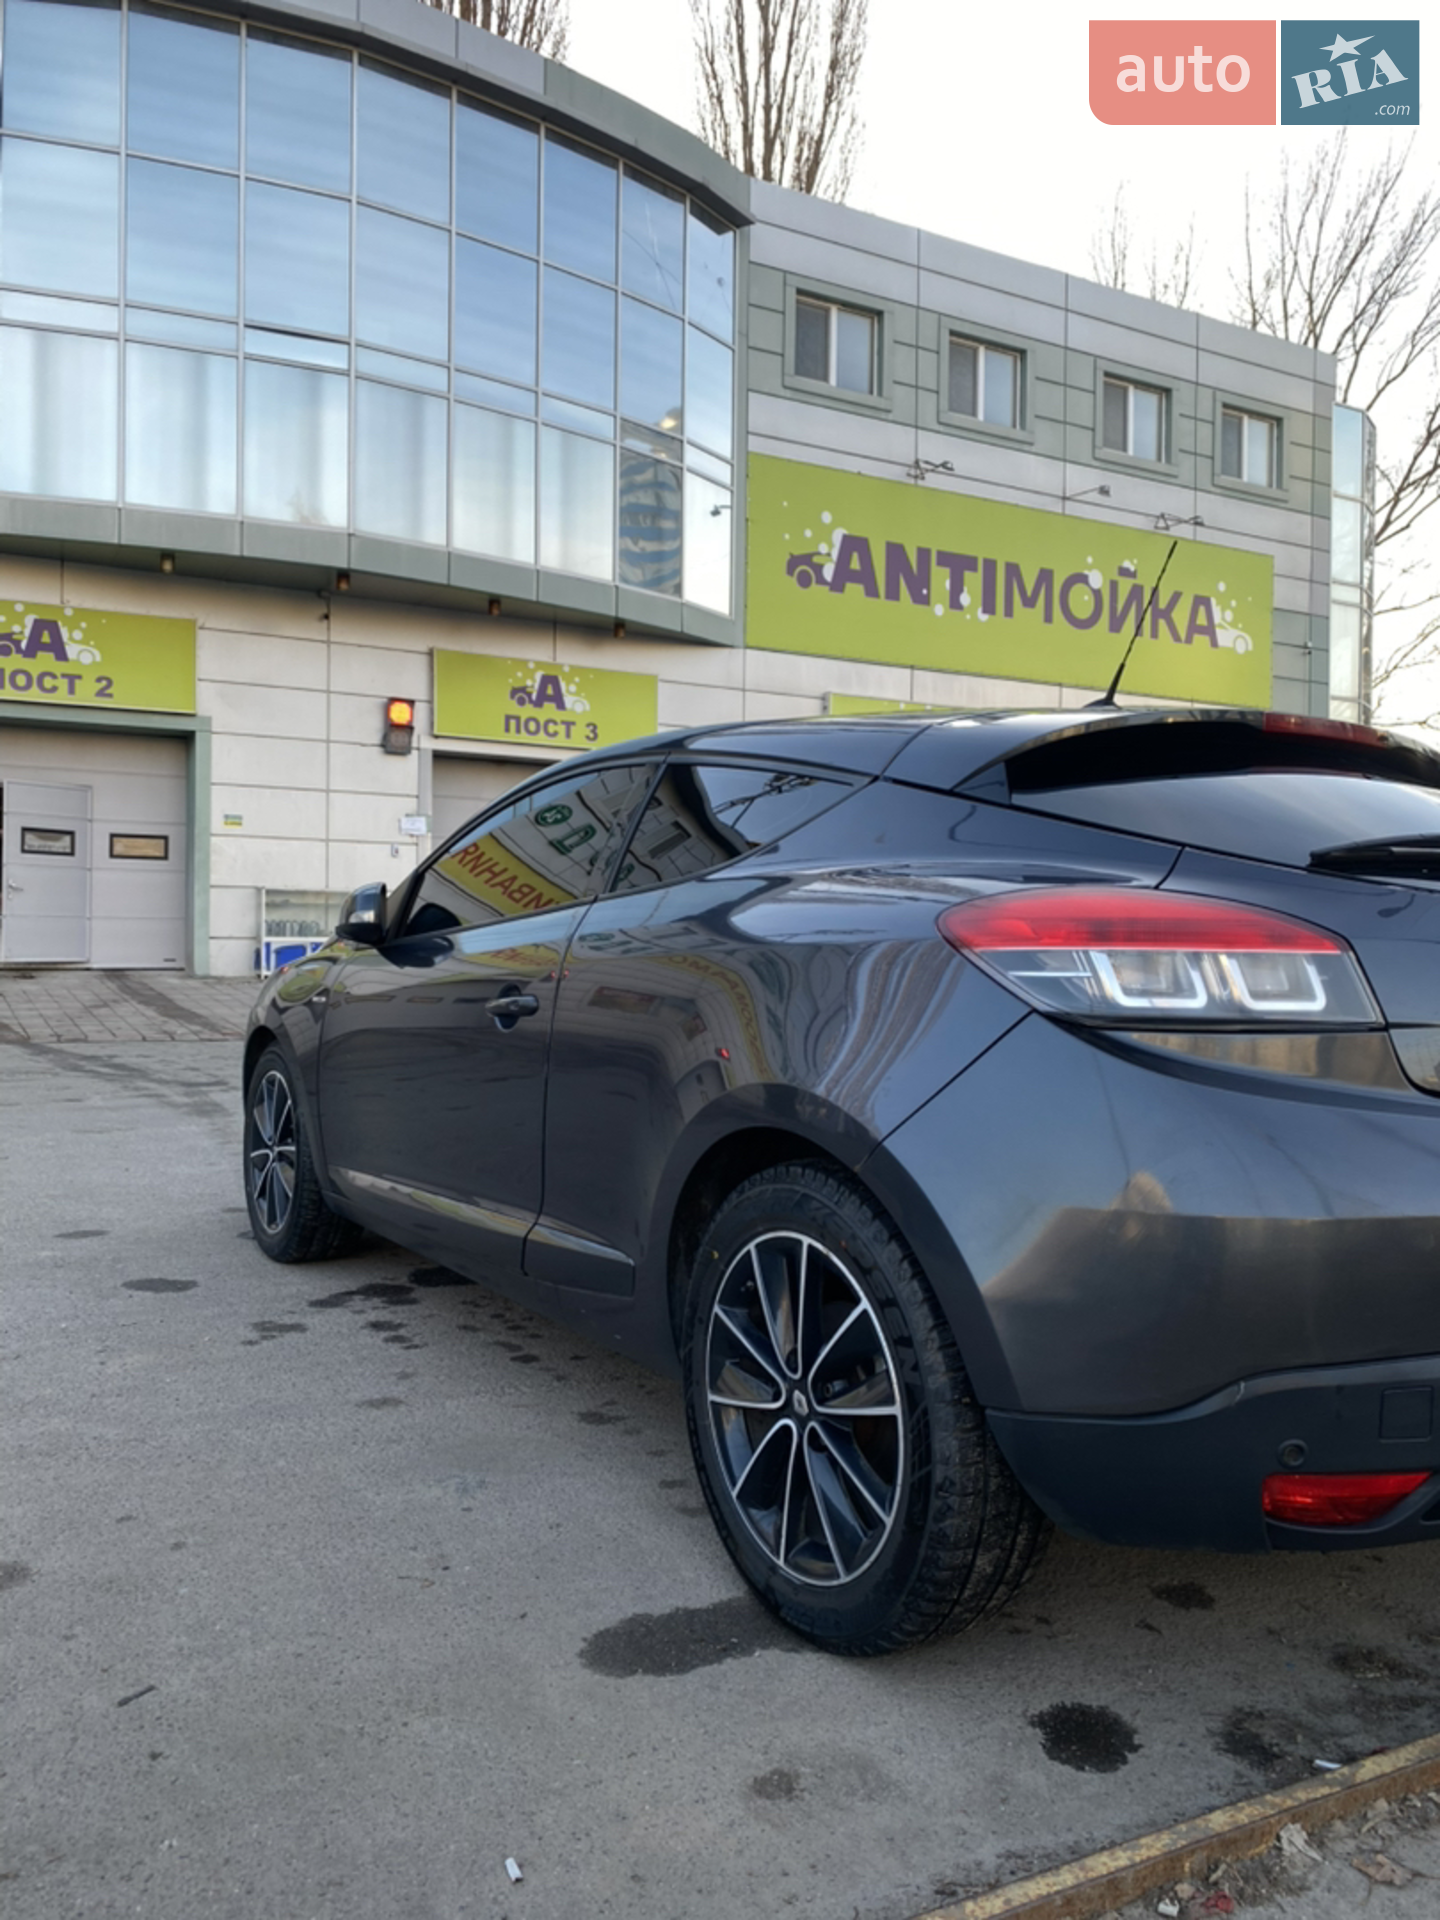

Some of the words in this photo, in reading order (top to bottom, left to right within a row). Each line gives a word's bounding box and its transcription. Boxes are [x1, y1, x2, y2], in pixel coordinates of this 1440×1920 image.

[94, 675, 115, 699] 2
[504, 714, 577, 740] ПОСТ
[585, 721, 599, 742] 3
